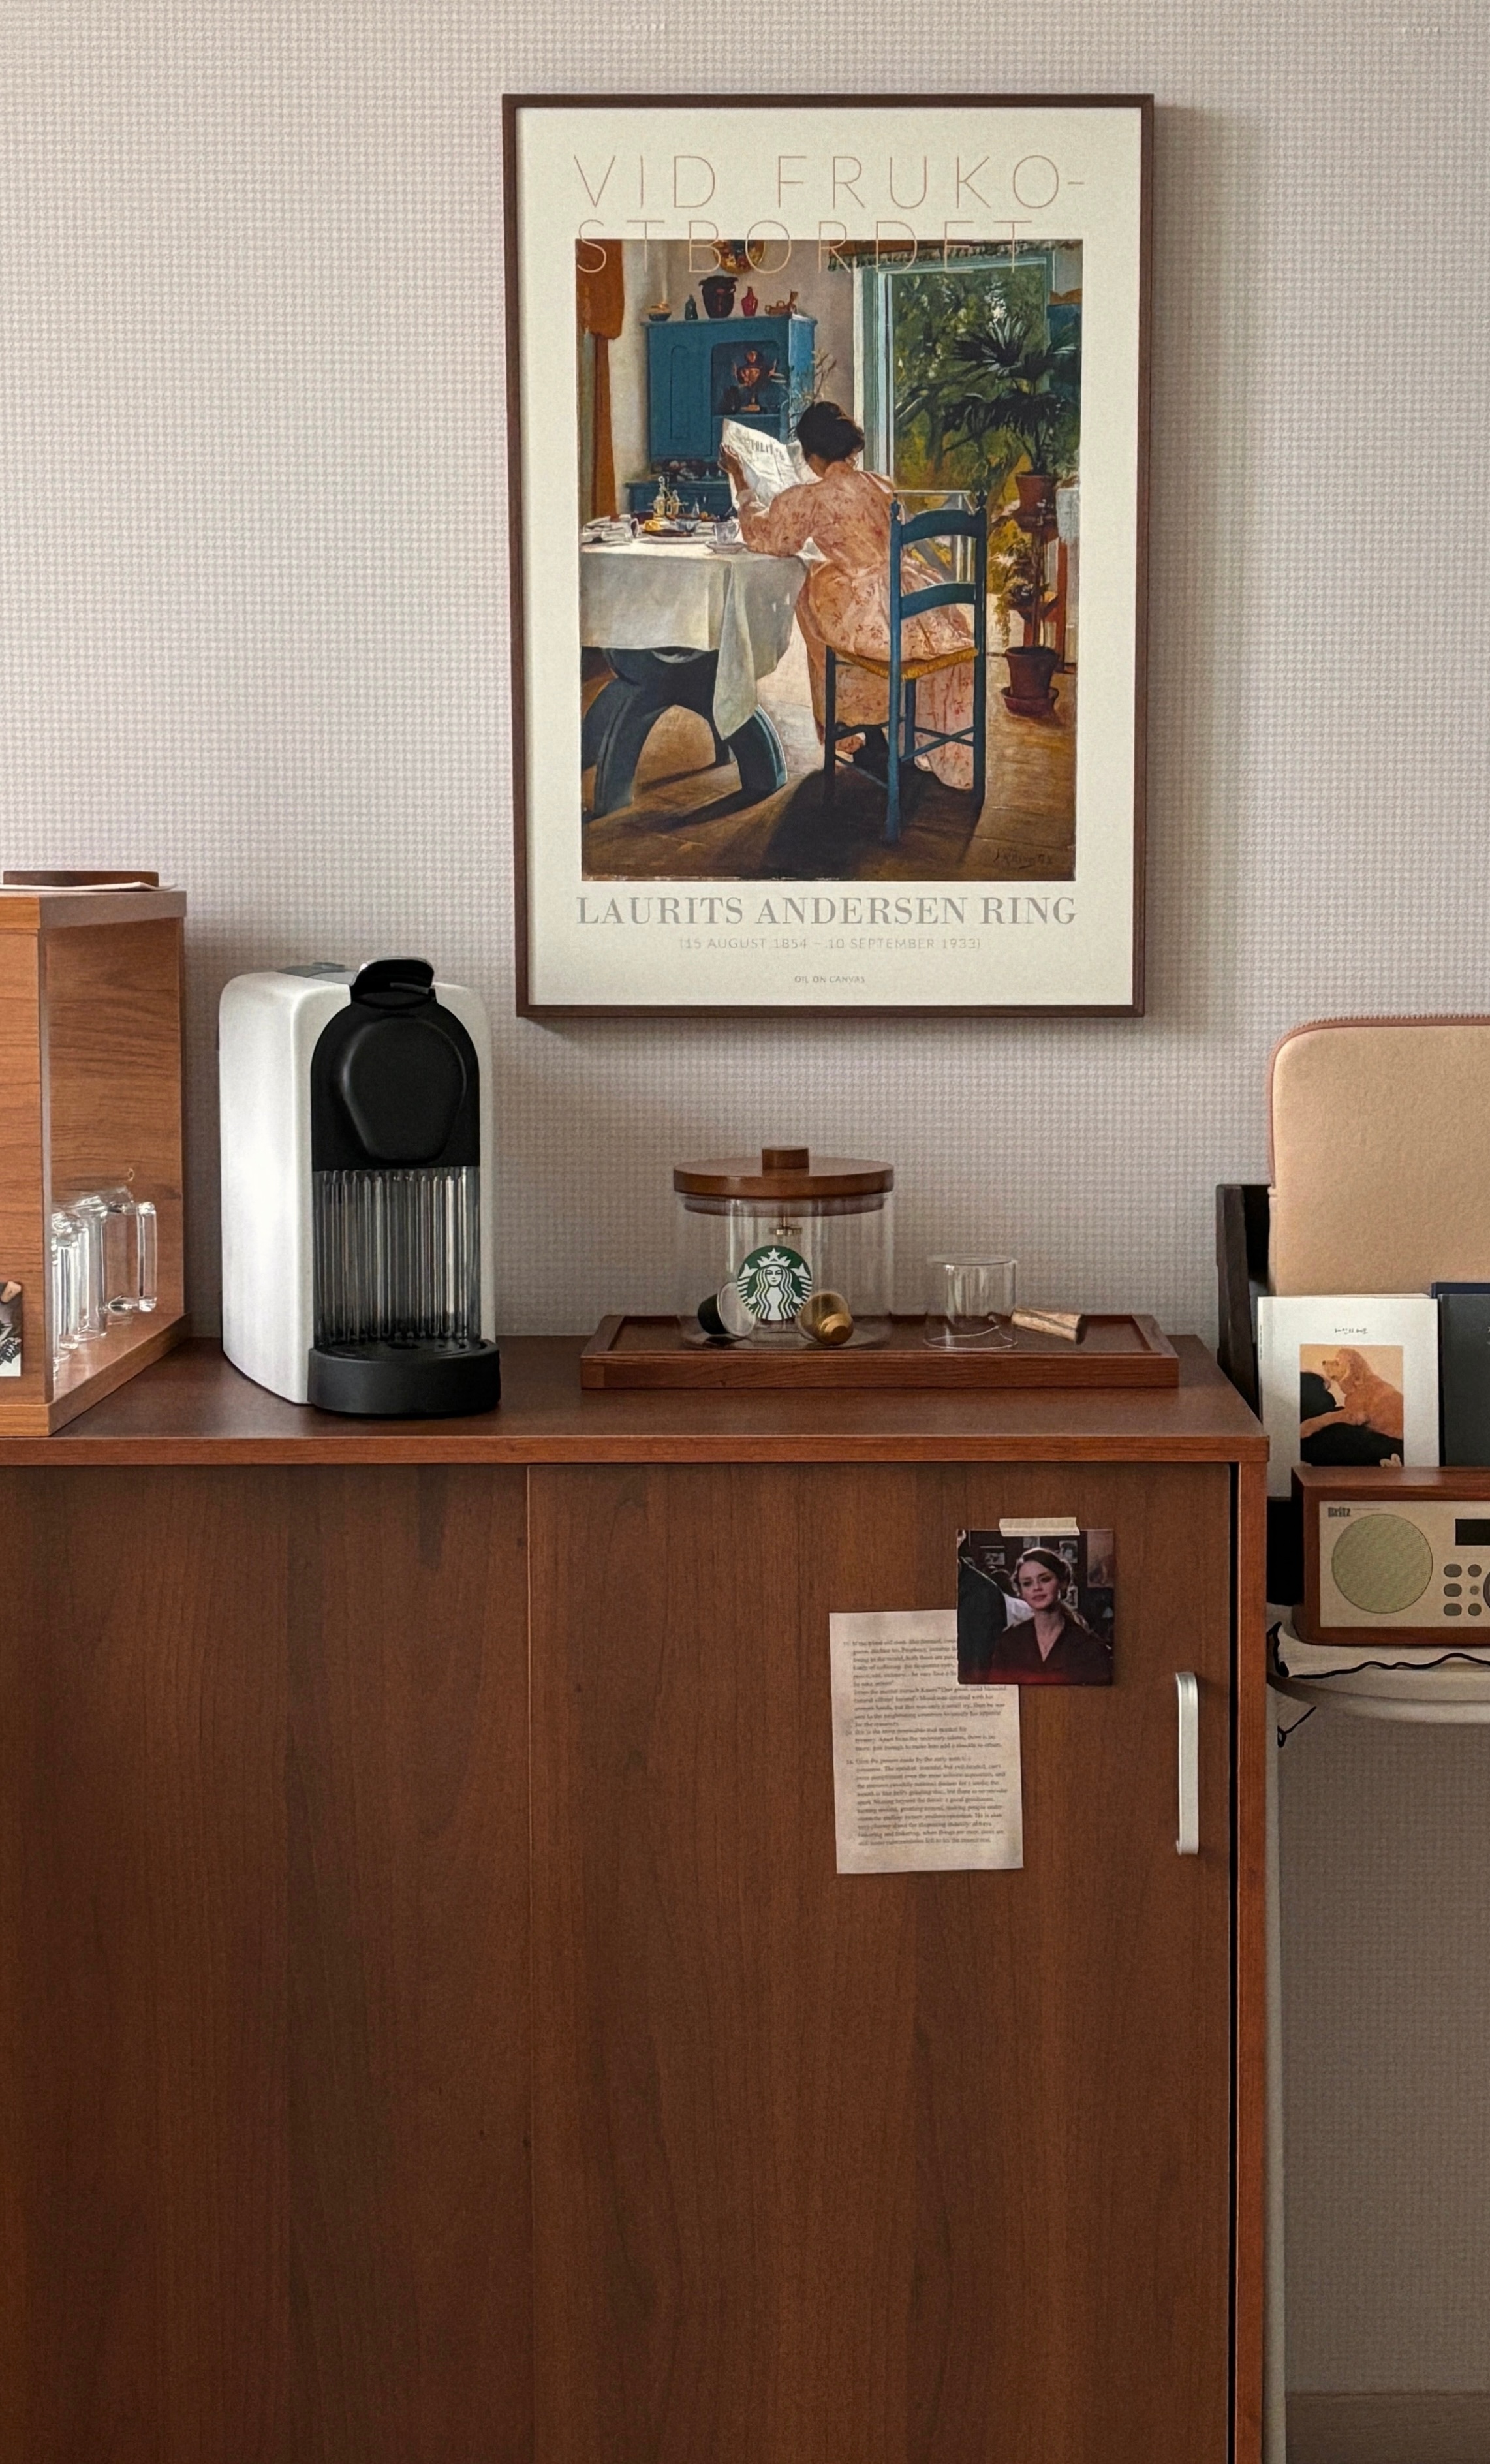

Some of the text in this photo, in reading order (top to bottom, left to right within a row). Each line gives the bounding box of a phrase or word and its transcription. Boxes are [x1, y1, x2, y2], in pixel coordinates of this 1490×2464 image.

[574, 154, 1085, 209] VID FRUKO-
[577, 218, 1032, 274] STBORDET
[576, 896, 1078, 925] LAURITS ANDERSEN RING
[707, 937, 767, 949] AUGUST
[774, 937, 807, 949] 1854
[828, 938, 844, 949] 10
[850, 938, 934, 949] SEPTEMBER
[943, 938, 980, 950] 1933)
[794, 975, 809, 984] OIL
[829, 975, 865, 984] CANVAS
